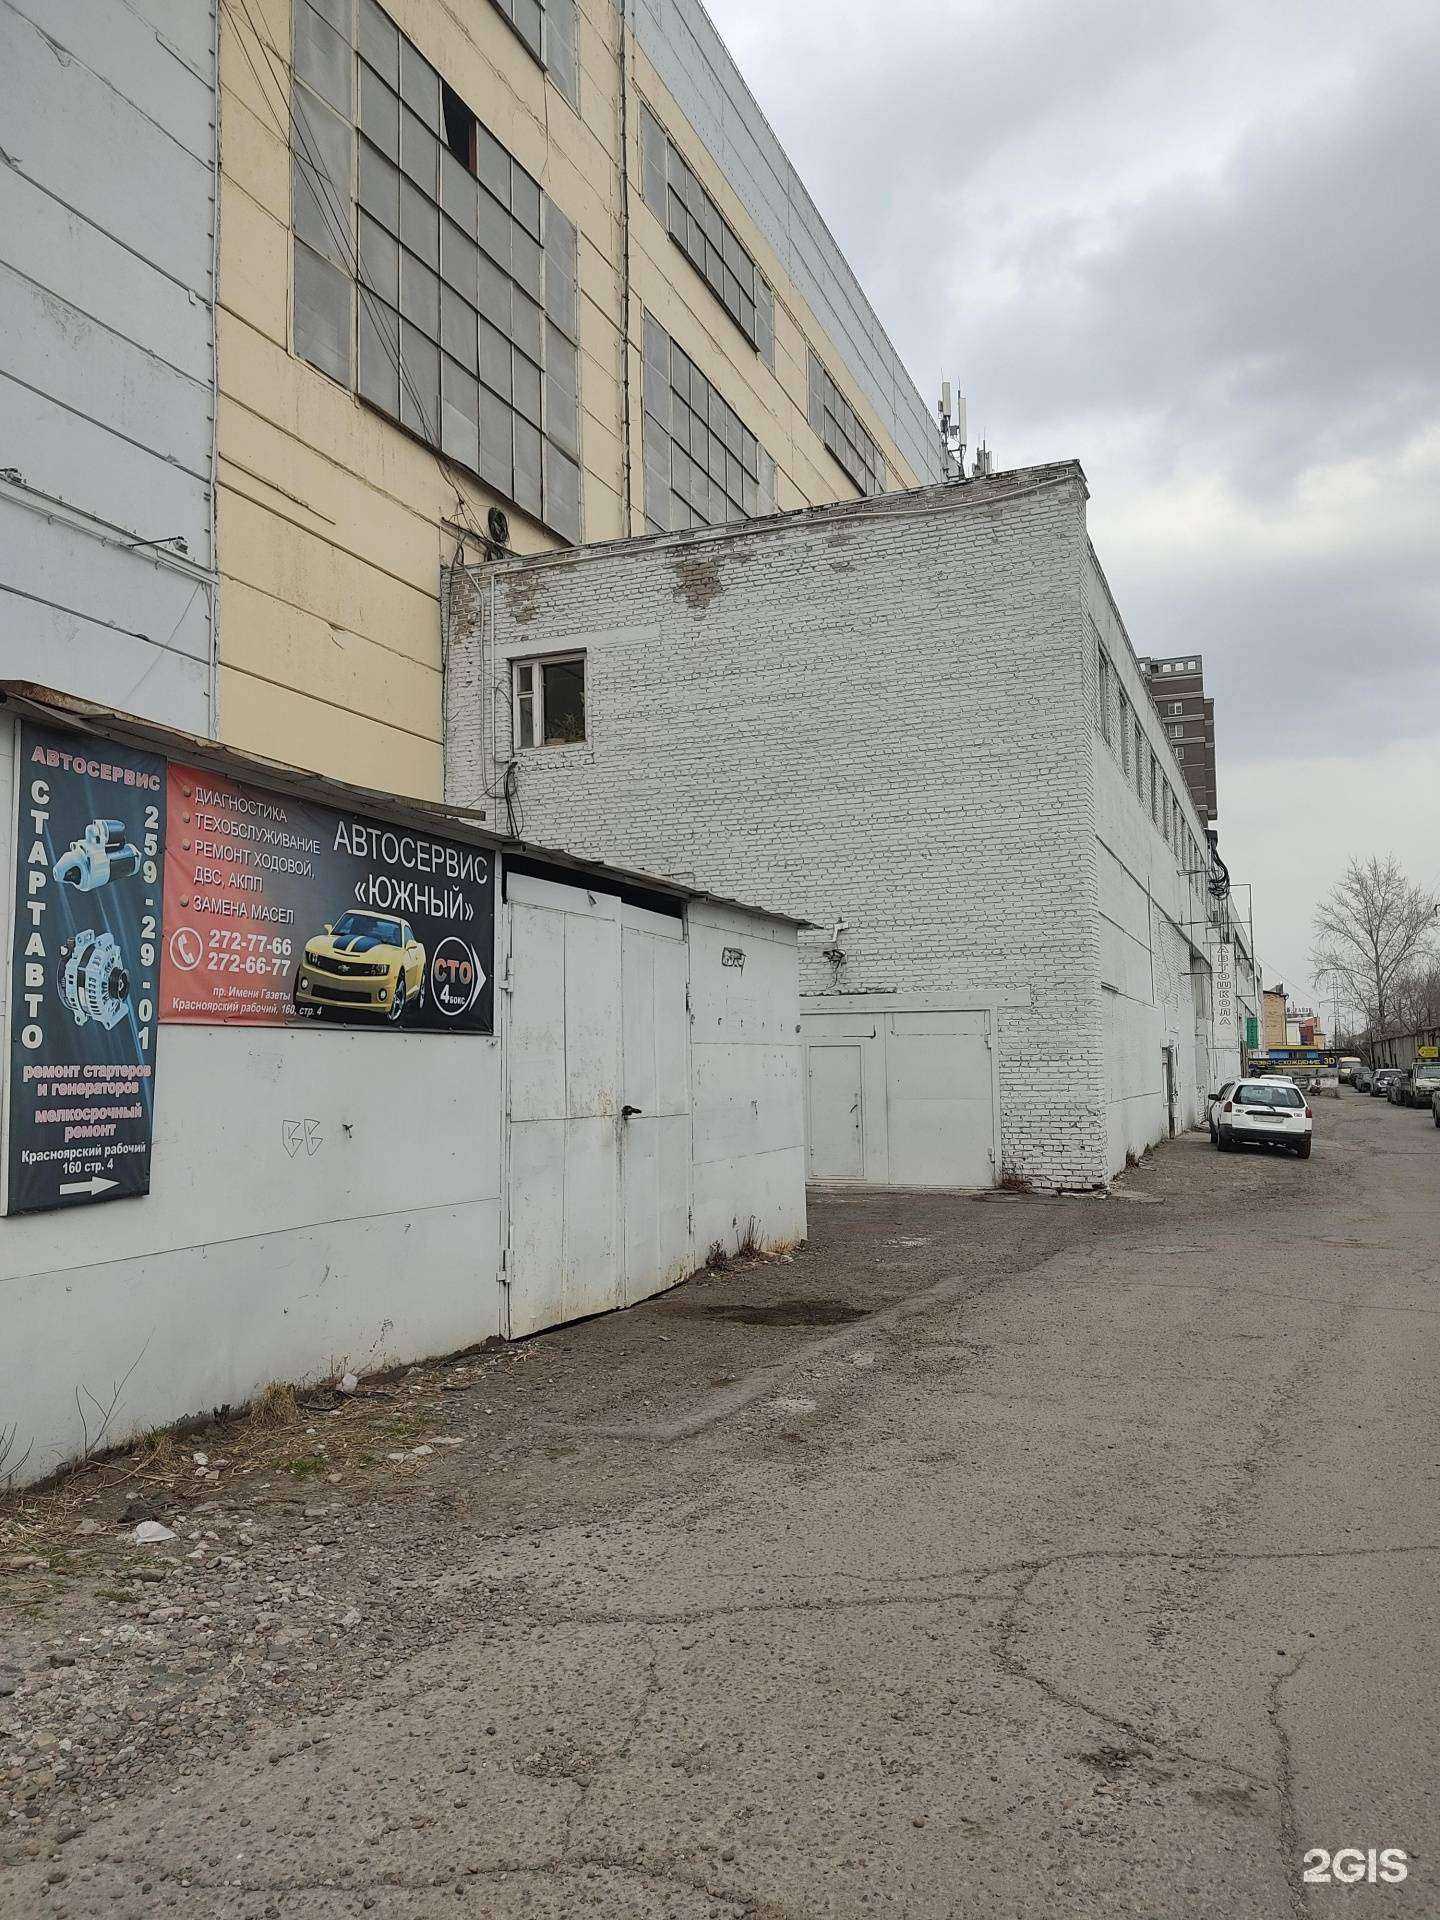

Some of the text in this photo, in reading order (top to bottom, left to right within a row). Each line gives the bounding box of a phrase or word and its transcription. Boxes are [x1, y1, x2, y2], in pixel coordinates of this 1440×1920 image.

[31, 746, 160, 791] АВТОСЕРВИС
[195, 787, 288, 822] ДИАГНОСТИКА
[195, 813, 320, 854] ТЕХОБСЛУЖИВАНИЕ
[194, 840, 315, 879] РЕМОНТ ХОДОВОЙ,
[333, 820, 488, 884] АВТОСЕРВИС
[193, 866, 263, 892] ДВС, АКПП
[193, 895, 294, 924] ЗАМЕНА МАСЕЛ
[354, 874, 474, 921] «ЮЖНЫЙ»
[21, 780, 50, 1049] СТАРТАВТО
[138, 805, 159, 1050] 259-29-01
[208, 929, 292, 956] 272-77-66
[207, 951, 291, 976] 272-66-77
[434, 958, 472, 985] СТО
[212, 985, 290, 1000] пр. Имени Газеты
[440, 985, 449, 1004] 4
[172, 997, 322, 1016] Красноярский рабочий, 160, стр. 4
[23, 1065, 151, 1082] ремонт стартеров
[1323, 1057, 1335, 1065] 3D
[37, 1081, 139, 1098] и генераторов
[35, 1102, 142, 1123] мелкосрочный
[65, 1123, 116, 1142] ремонт
[21, 1141, 146, 1165] Красноярский рабочий
[63, 1158, 114, 1174] 160 стр. 4
